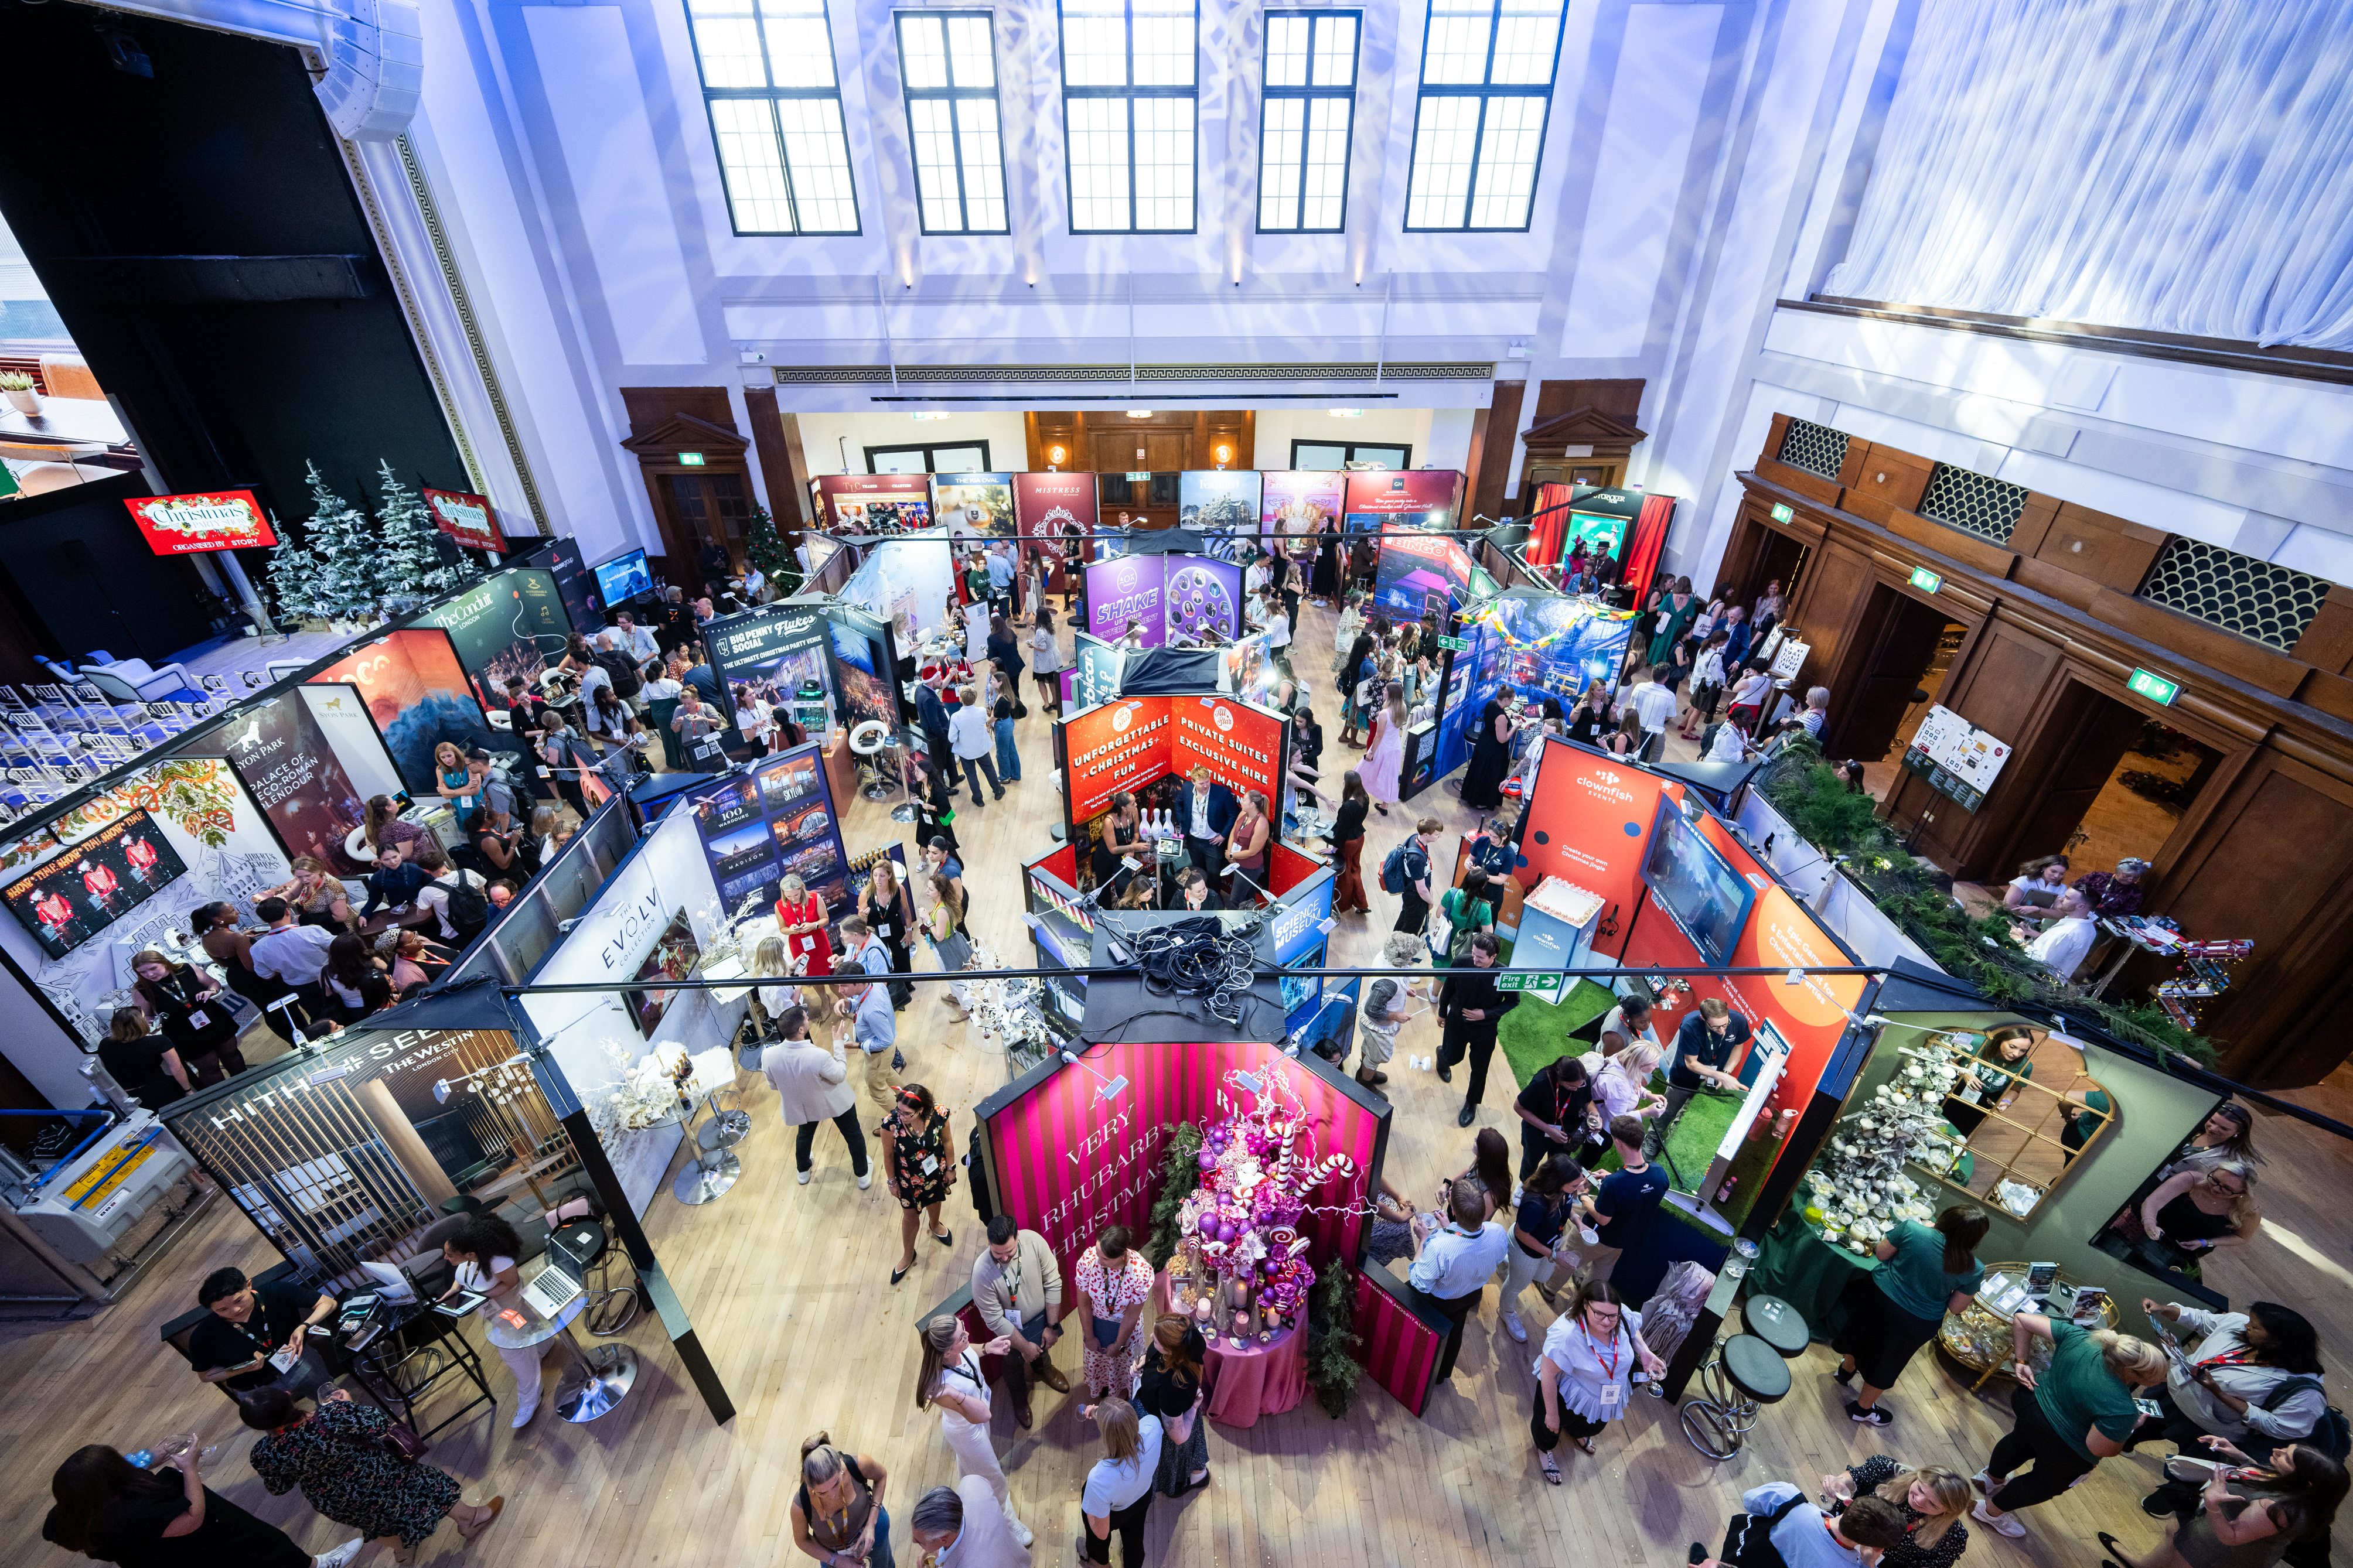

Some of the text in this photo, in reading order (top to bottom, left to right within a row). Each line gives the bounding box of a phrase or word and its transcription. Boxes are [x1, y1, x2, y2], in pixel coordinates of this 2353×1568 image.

[1199, 479, 1235, 489] Foxhills
[153, 504, 244, 524] Christmas
[438, 501, 486, 521] Christmas
[193, 517, 247, 529] PARTY SHOW
[172, 541, 214, 551] ORGANISED
[231, 538, 258, 546] STORY
[1393, 538, 1445, 556] BINGO
[609, 571, 626, 582] worldwide
[626, 566, 636, 575] reach
[1096, 587, 1160, 625] SHAKE
[459, 614, 481, 630] LONDON
[729, 631, 745, 645] BIG
[745, 624, 773, 641] PENNY
[774, 614, 817, 637] Flukes
[1114, 612, 1143, 626] UP YOUR
[722, 635, 823, 670] THE ULTIMATE CHRISTMAS PARTY VENUE
[732, 637, 764, 654] SOCIAL
[1100, 685, 1109, 694] at
[1116, 708, 1125, 722] All
[1116, 714, 1130, 730] Star
[1215, 708, 1227, 718] All
[1217, 716, 1232, 727] Star
[1074, 714, 1169, 768] UNFORGETTABLE
[1181, 716, 1268, 764] PRIVATE SUITES
[235, 737, 286, 771] SYON PARK
[291, 753, 305, 766] OF
[1089, 737, 1154, 777] CHRISTMAS
[1179, 735, 1268, 785] EXCLUSIVE HIRE
[1114, 762, 1135, 780] FUN
[783, 784, 803, 801] SKYLON
[1084, 797, 1094, 806] Party
[1117, 780, 1128, 789] lavish
[1128, 774, 1140, 784] private
[1140, 767, 1154, 777] bowling
[1154, 761, 1164, 770] suites
[1090, 800, 1103, 809] You've
[1121, 783, 1135, 792] bowled
[1147, 771, 1159, 779] before
[1577, 777, 1633, 802] clownfish
[1588, 790, 1617, 804] EVENTS
[718, 814, 745, 828] WARDOUR
[721, 807, 742, 821] 100
[792, 828, 805, 836] NEW
[1562, 844, 1608, 866] Create your own
[1681, 815, 1692, 831] Catch
[1697, 833, 1731, 873] clownfishevents.com
[728, 852, 764, 870] MADISON
[1561, 850, 1606, 872] Christmas jingle
[619, 903, 632, 919] THE
[1275, 898, 1320, 939] SCIENCE
[1652, 885, 1660, 898] Epic
[1659, 894, 1669, 908] events.
[1667, 904, 1680, 922] Grinning
[1677, 920, 1689, 935] guests.
[1687, 931, 1706, 956] Guaranteed.
[601, 887, 656, 969] EVOLV
[1275, 908, 1321, 952] MUSEUM
[1786, 924, 1803, 946] Epic
[619, 917, 656, 967] COLLECTION
[1533, 934, 1560, 951] clownfish
[1770, 923, 1835, 998] & for
[1725, 986, 1734, 999] free
[1733, 997, 1745, 1014] game
[1744, 1012, 1753, 1025] hire
[1737, 993, 1749, 1009] score
[1748, 1007, 1759, 1022] wins
[1763, 1022, 1788, 1054] LEADERBOARD
[382, 1030, 475, 1075] THE WESTIN
[412, 1047, 461, 1072] LONDON CITY
[210, 1078, 311, 1130] HITH
[1065, 1102, 1135, 1165] VERY
[1041, 1125, 1160, 1234] RHUBARB
[1052, 1153, 1169, 1259] HRISTMAS
[1366, 1280, 1432, 1335] RHUBARB_HOSPITALITY
